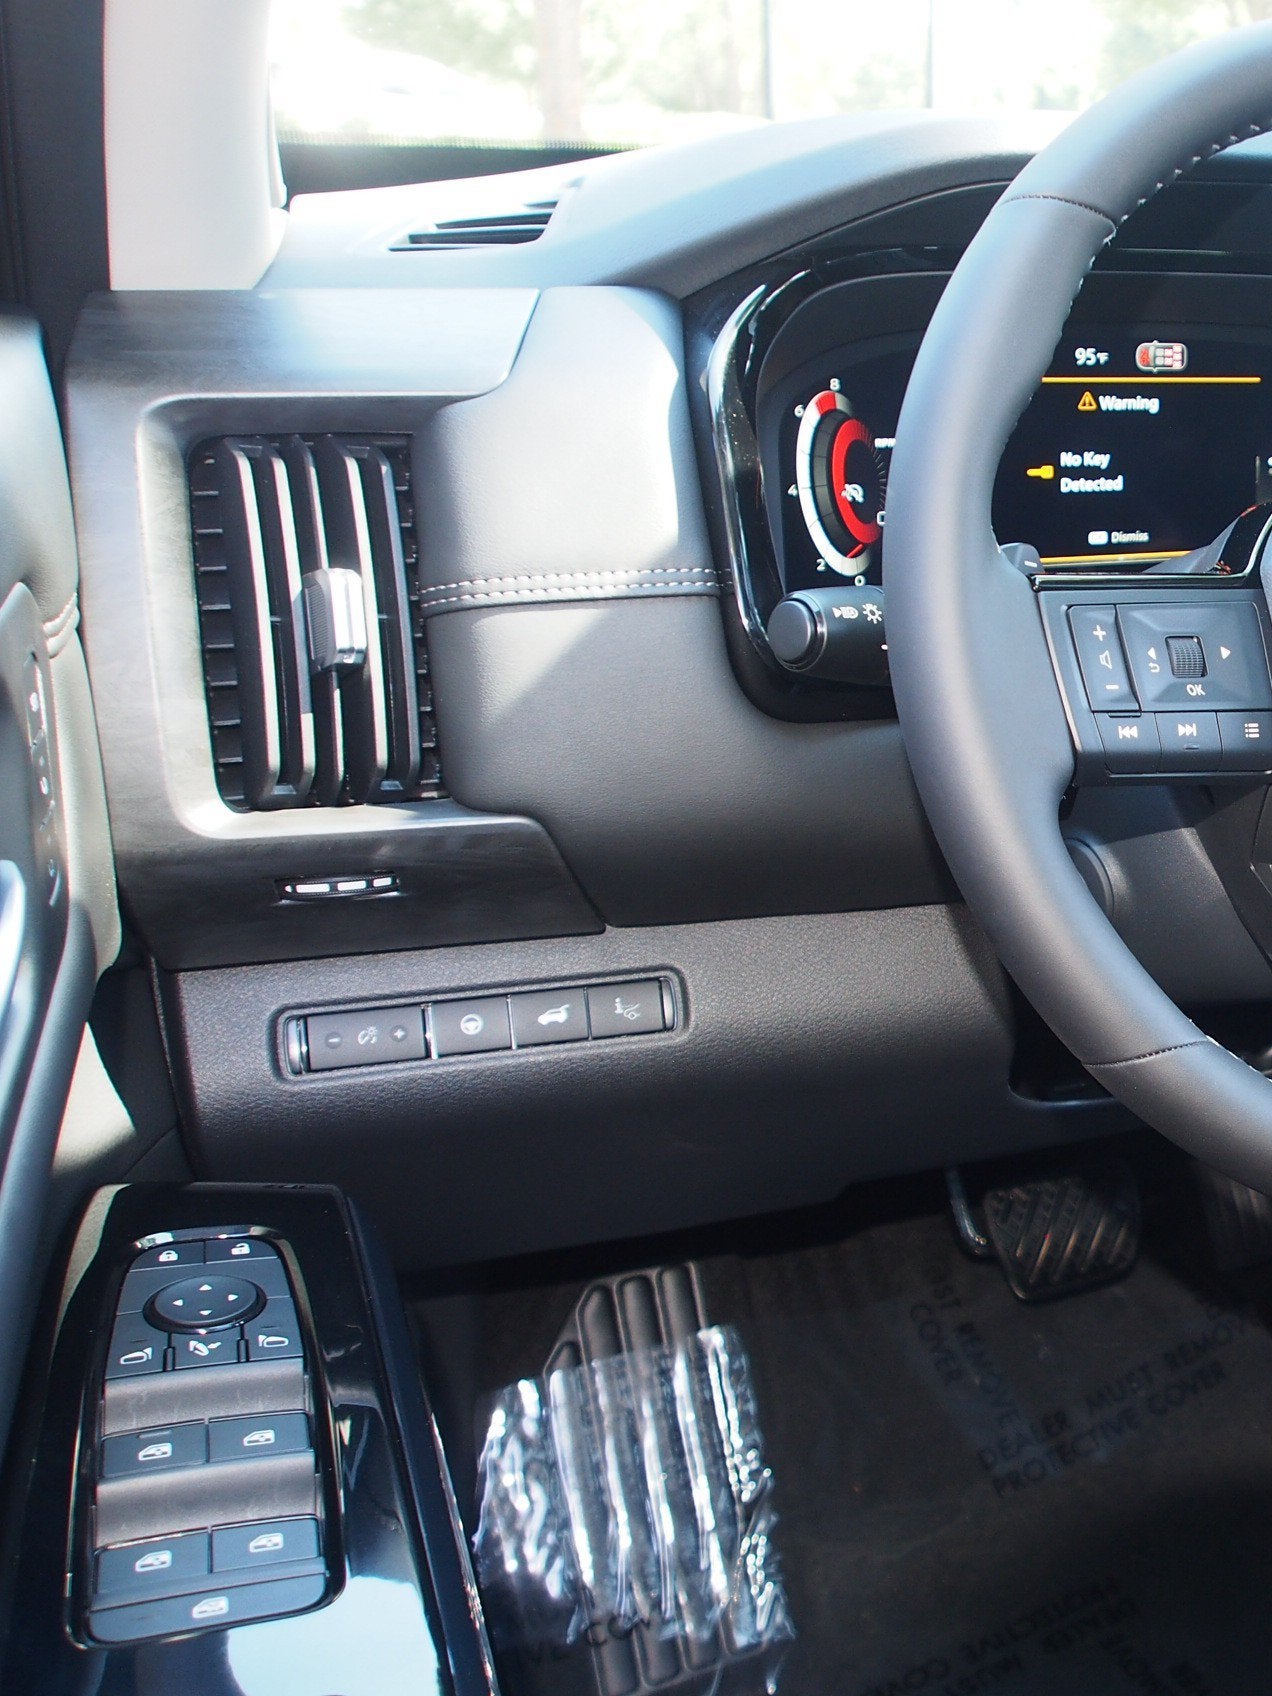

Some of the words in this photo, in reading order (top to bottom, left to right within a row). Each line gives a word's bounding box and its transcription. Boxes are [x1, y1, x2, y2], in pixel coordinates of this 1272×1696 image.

[829, 378, 841, 391] 8
[794, 404, 805, 418] 6
[1099, 395, 1160, 414] Warning
[1060, 451, 1082, 467] No
[1083, 451, 1110, 470] Key
[787, 484, 798, 497] 4
[1060, 475, 1124, 493] Detected
[1110, 530, 1149, 544] Dismiss
[816, 559, 827, 571] 2
[854, 575, 865, 587] 0
[1186, 684, 1206, 697] OK
